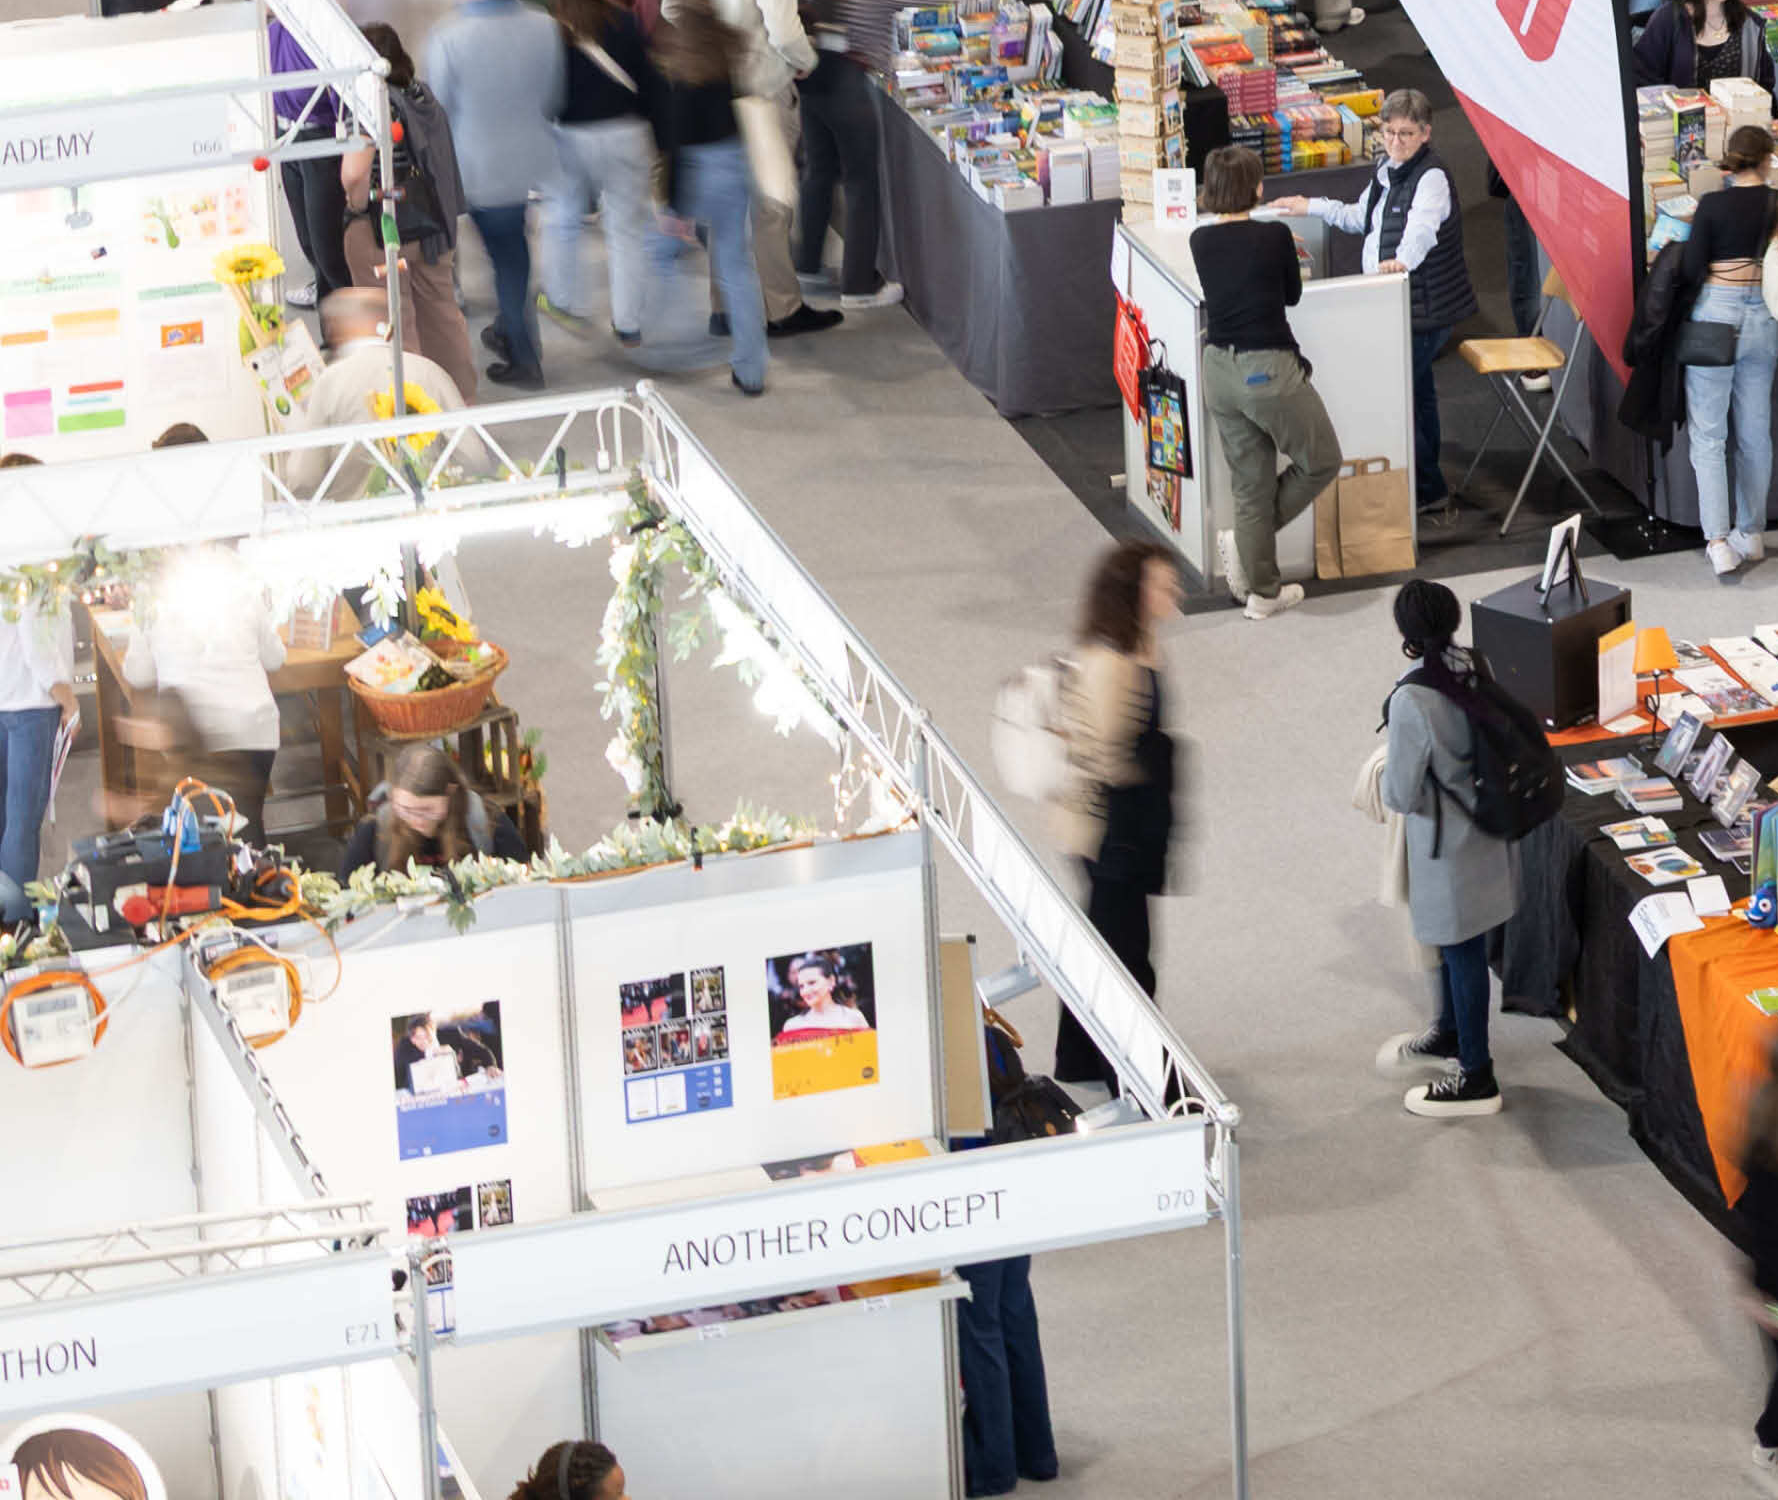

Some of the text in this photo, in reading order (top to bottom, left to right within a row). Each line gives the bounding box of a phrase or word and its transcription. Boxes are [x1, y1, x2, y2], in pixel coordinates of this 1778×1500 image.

[662, 1189, 1195, 1275] ANOTHER CONCEPT D70
[0, 1322, 381, 1382] THON E71
